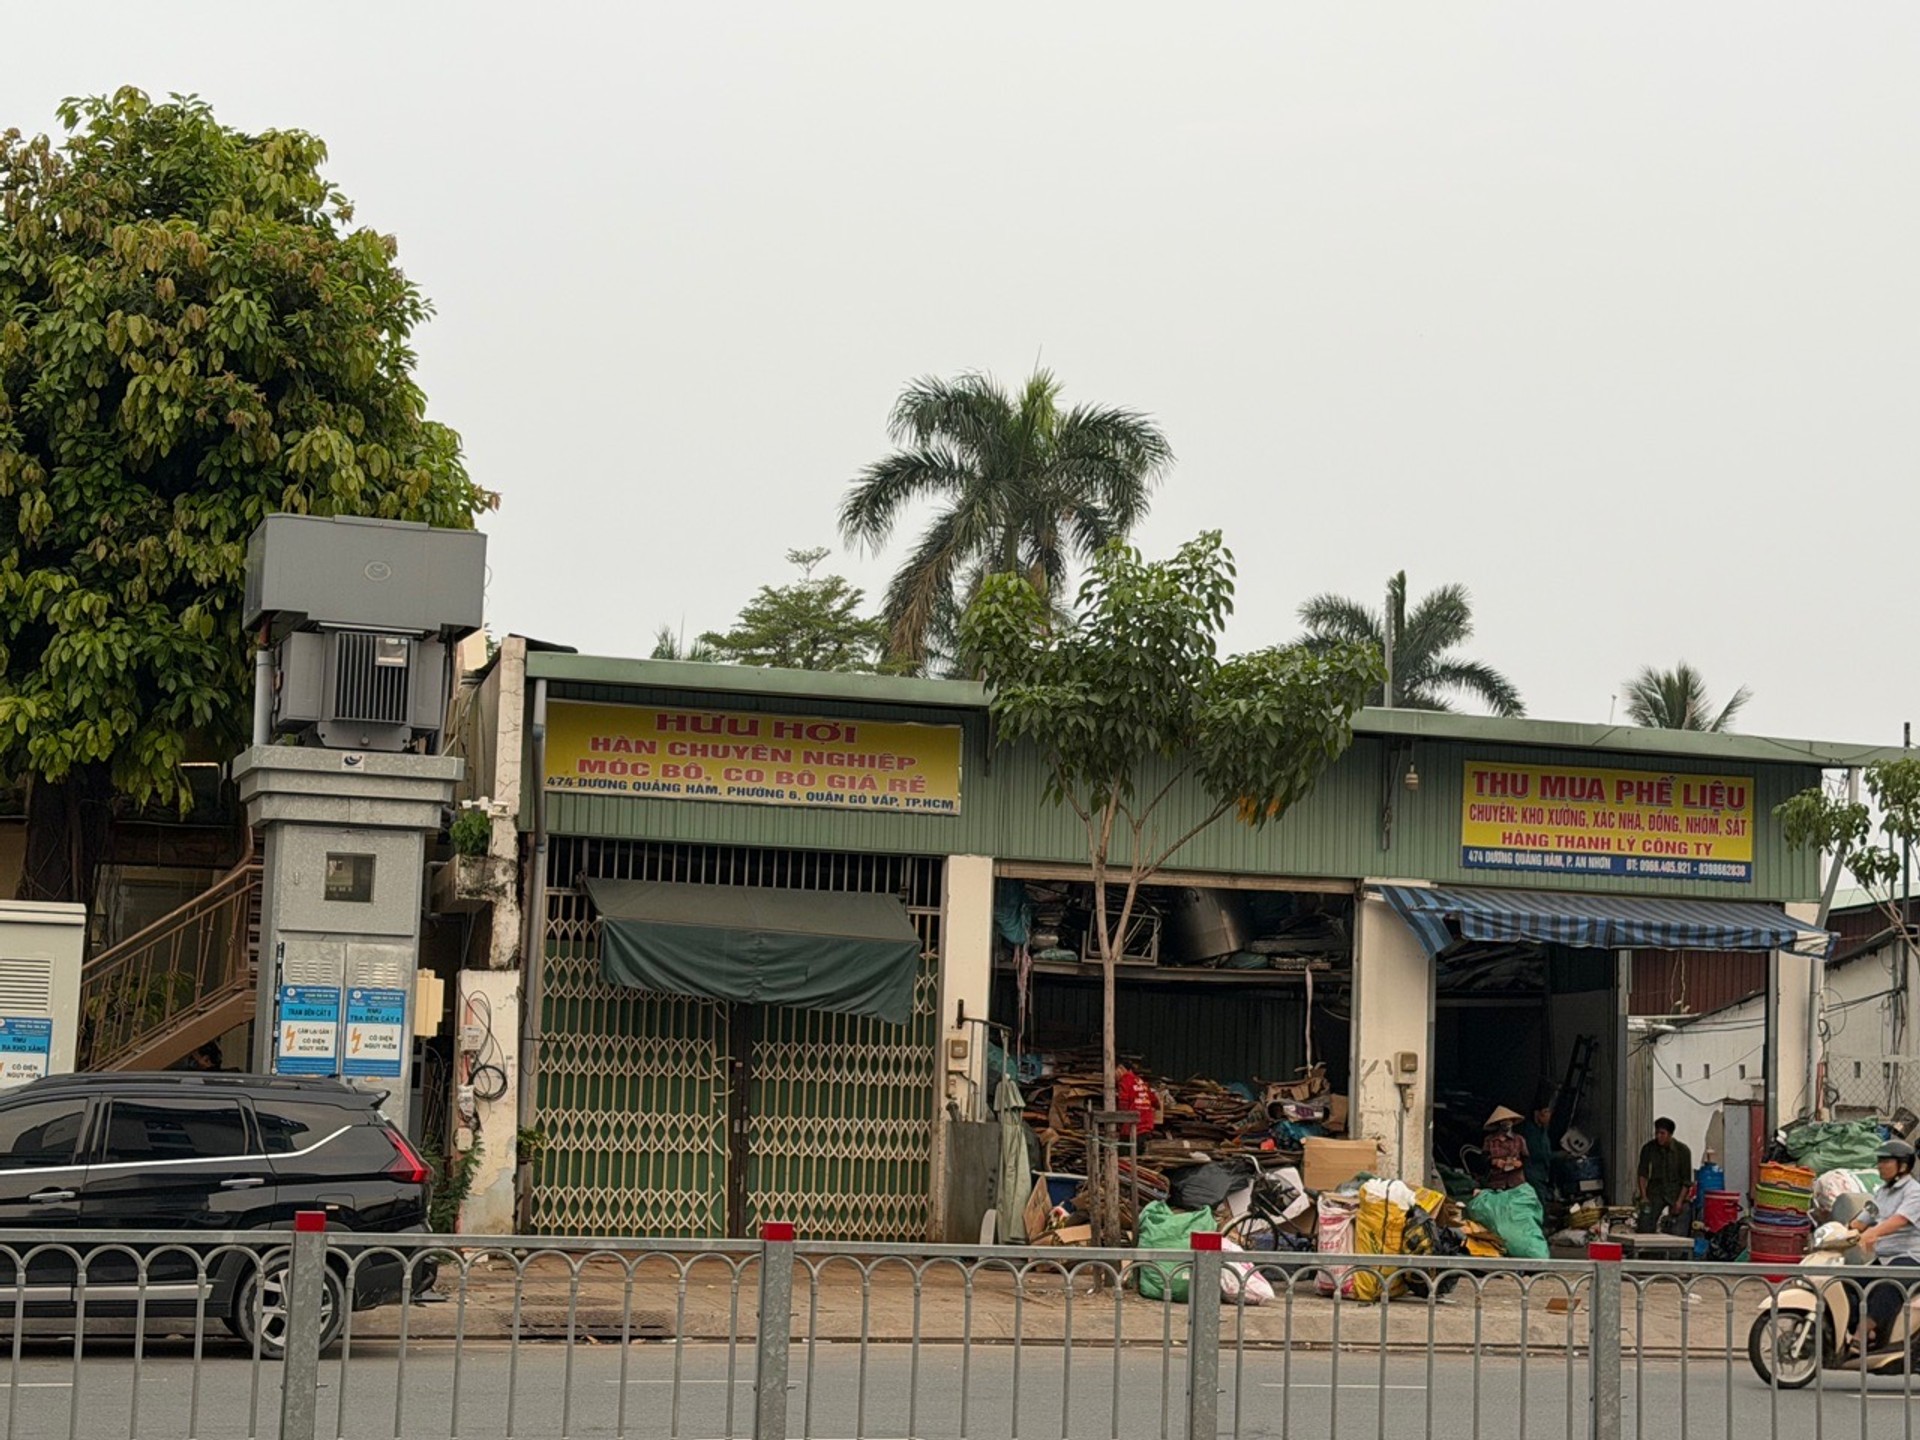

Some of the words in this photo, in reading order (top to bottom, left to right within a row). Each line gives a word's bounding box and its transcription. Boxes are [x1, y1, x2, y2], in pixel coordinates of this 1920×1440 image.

[591, 736, 657, 755] HÀN
[668, 741, 792, 763] CHUYÊN
[803, 751, 916, 772] NGHIỆP
[578, 758, 650, 777] MÓC
[723, 768, 764, 783] CO
[775, 769, 816, 787] BÔ
[826, 774, 878, 791] GIÁ
[888, 775, 926, 794] RẺ
[547, 777, 573, 788] 474
[632, 779, 680, 793] QUẢNG
[849, 793, 868, 805] GÒ
[905, 797, 954, 810] TP.HCM
[1472, 771, 1530, 798] THU
[1540, 775, 1606, 802] MUA
[1616, 775, 1676, 807] PHẾ
[1683, 780, 1746, 815] LIỆU
[1469, 802, 1518, 824] CHUYÊN:
[1521, 806, 1544, 826] KHO
[1593, 807, 1615, 829] XÁC
[1468, 850, 1483, 862] 474
[1515, 850, 1542, 866] QUẢNG
[1575, 856, 1587, 869] AN
[1502, 829, 1549, 848] HÀNG
[1555, 834, 1611, 851] THANH
[1617, 836, 1636, 852] LÝ
[1642, 837, 1688, 855] CÔNG
[1694, 842, 1713, 857] TY
